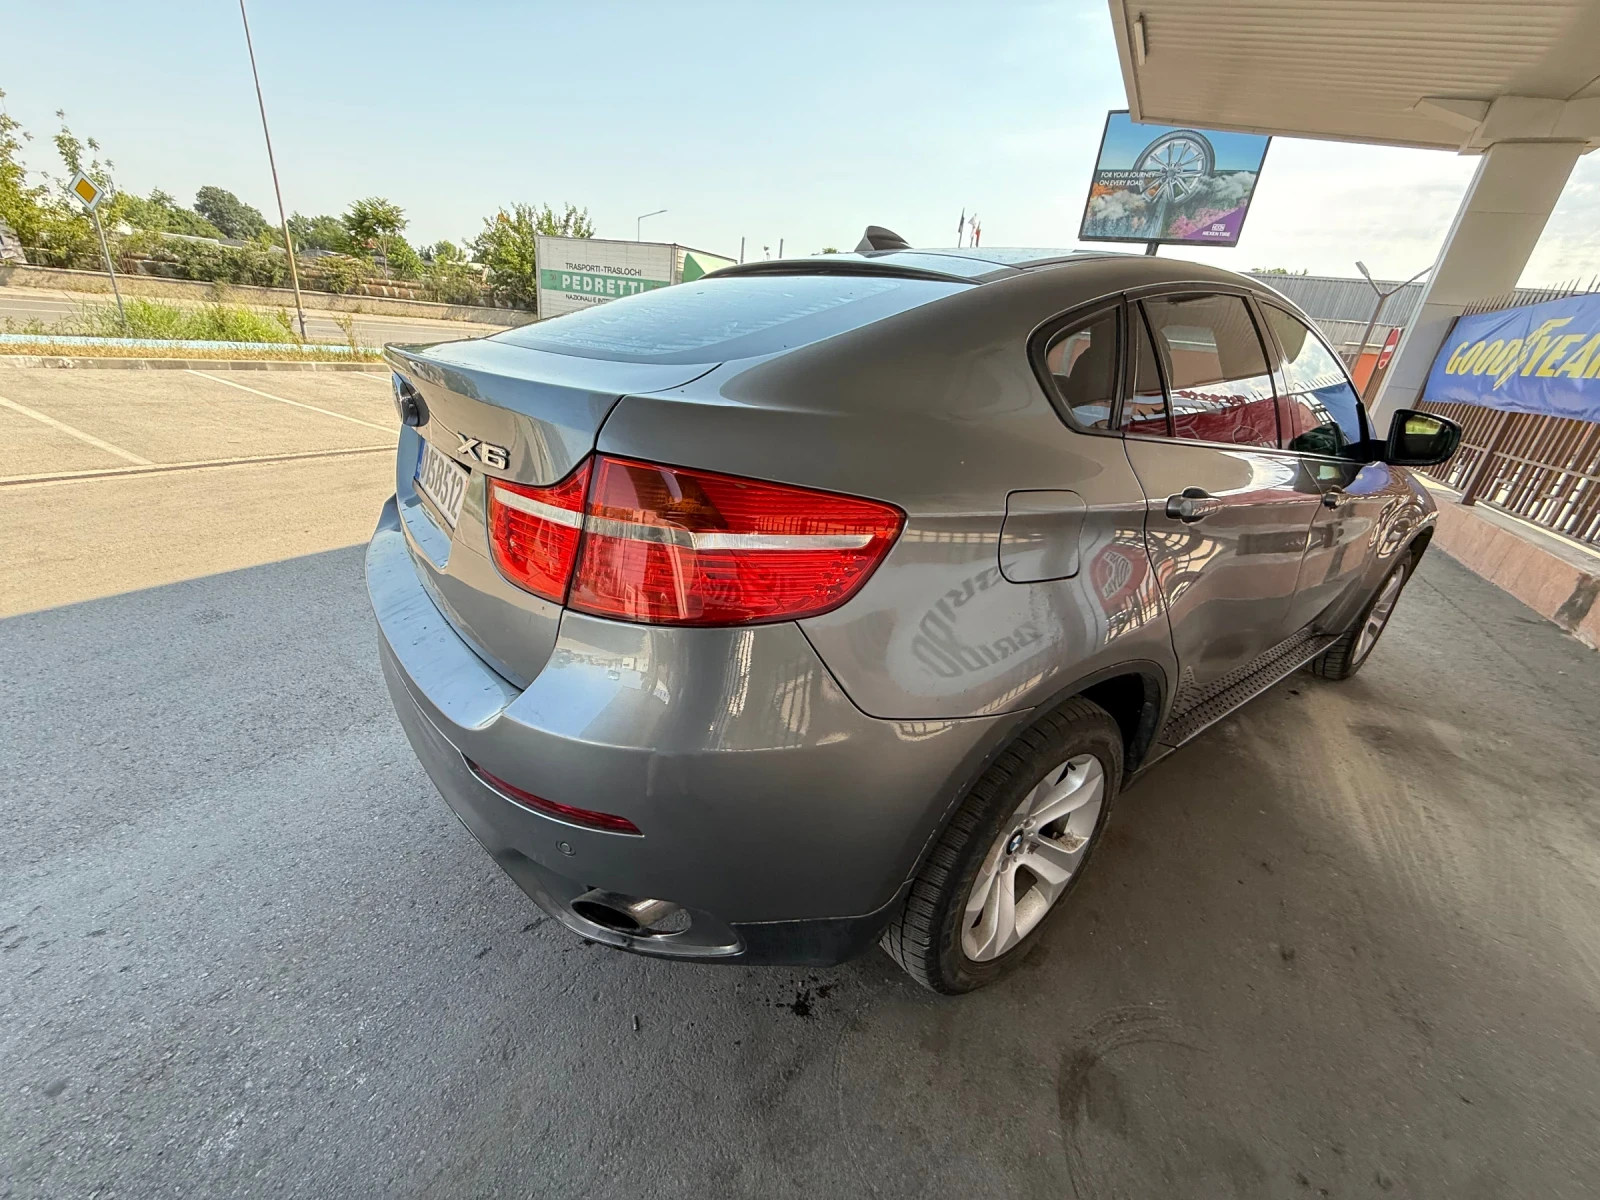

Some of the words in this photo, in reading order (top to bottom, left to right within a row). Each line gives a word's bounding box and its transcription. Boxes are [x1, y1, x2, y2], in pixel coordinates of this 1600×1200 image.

[562, 274, 645, 296] PEDRETTI
[565, 294, 593, 304] NAZIONALI
[456, 431, 511, 470] X6
